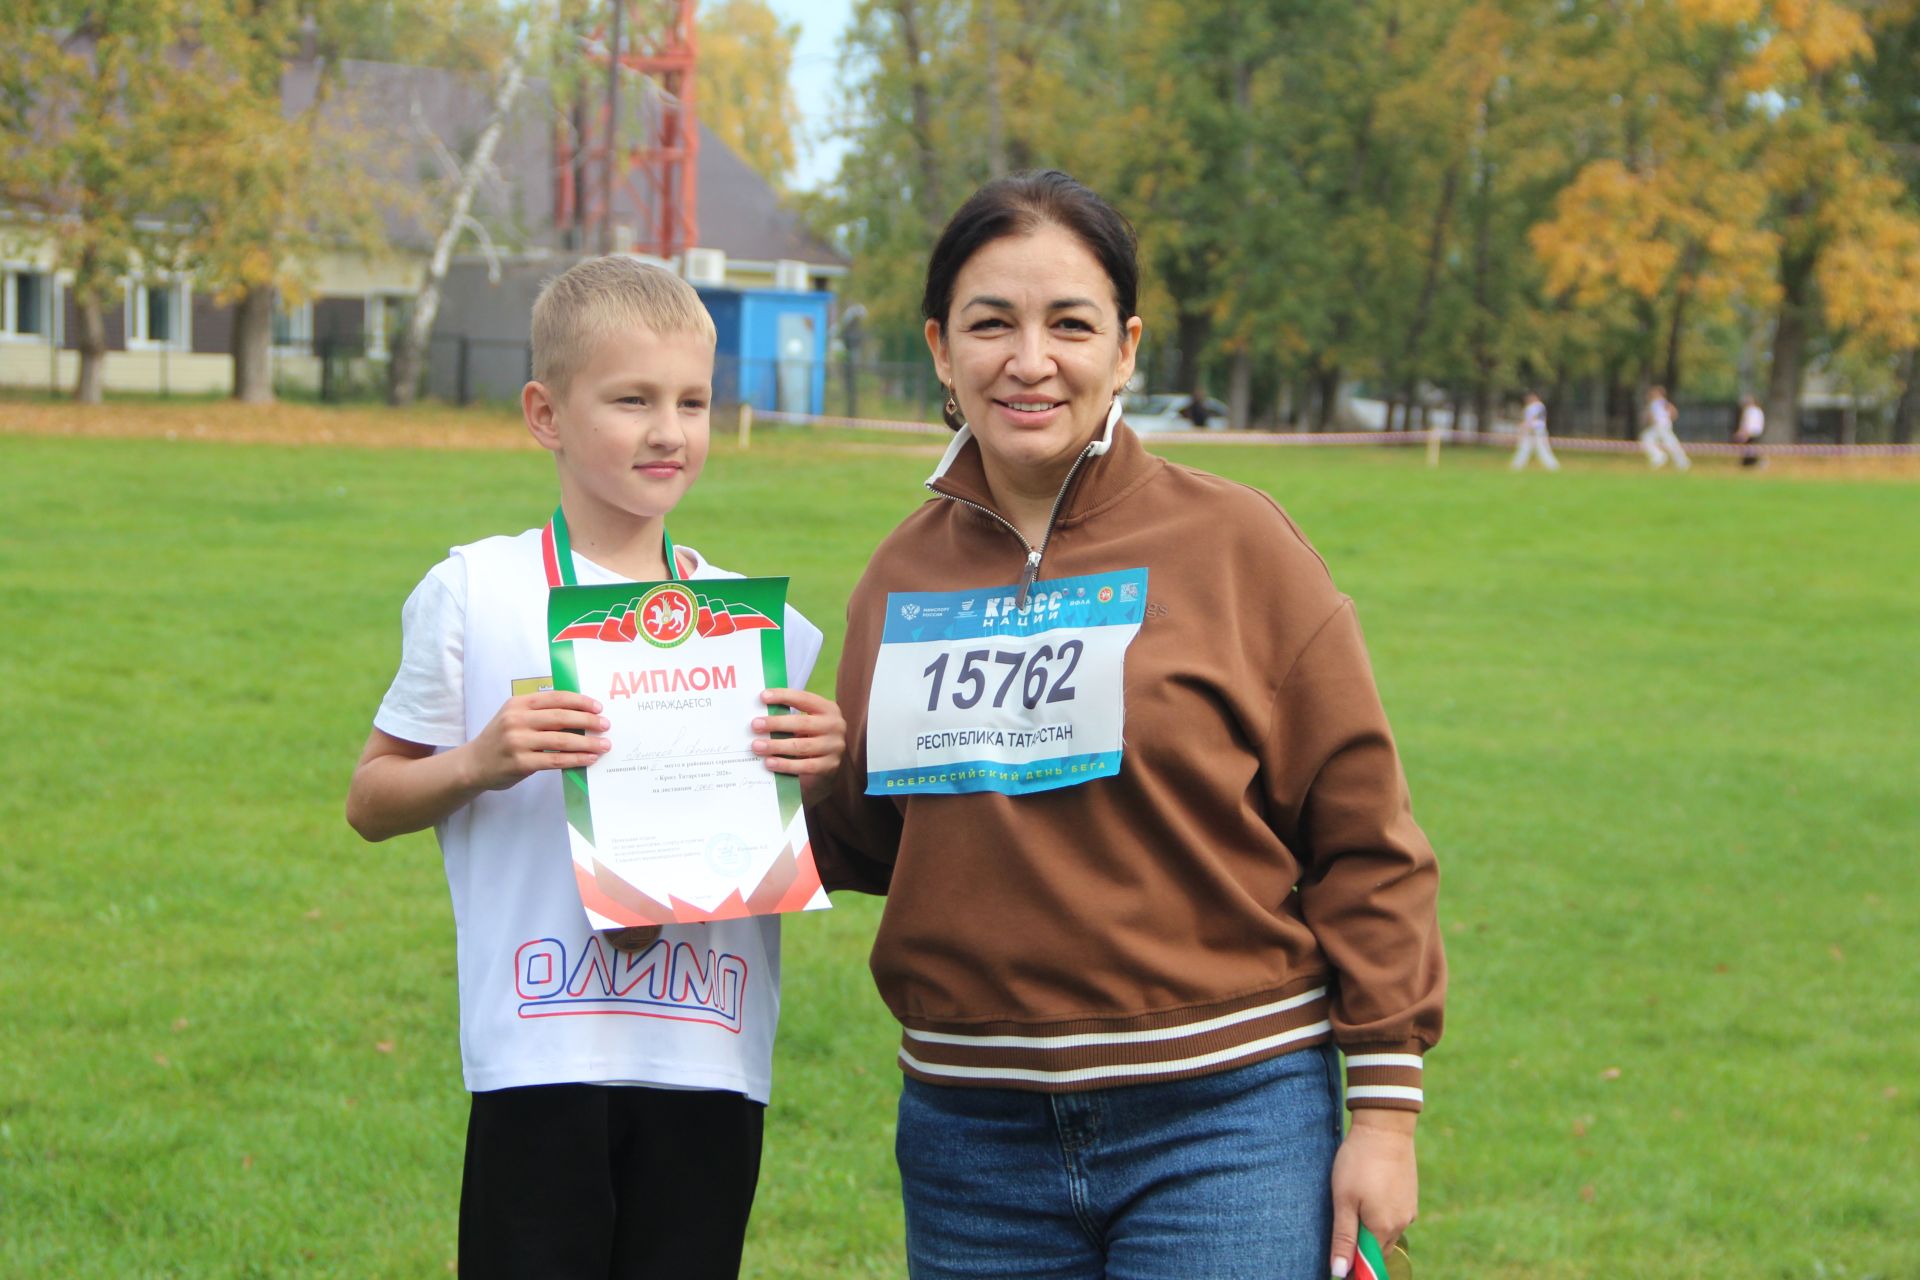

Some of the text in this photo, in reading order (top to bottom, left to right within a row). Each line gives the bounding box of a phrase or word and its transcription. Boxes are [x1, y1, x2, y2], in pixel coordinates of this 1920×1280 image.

[985, 591, 1063, 617] КРОСС
[983, 611, 1059, 628] НАЦИИ
[609, 665, 737, 700] ДИПЛОМ
[923, 639, 1084, 712] 15762
[637, 697, 712, 712] НАГРАЖДАЕТСЯ
[917, 729, 1004, 750] РЕСПУБЛИКА
[887, 762, 1106, 787] ВСЕРОССИЙСКИЙ ДЕНЬ БЕГА
[514, 935, 748, 1033] ОЛИМП
